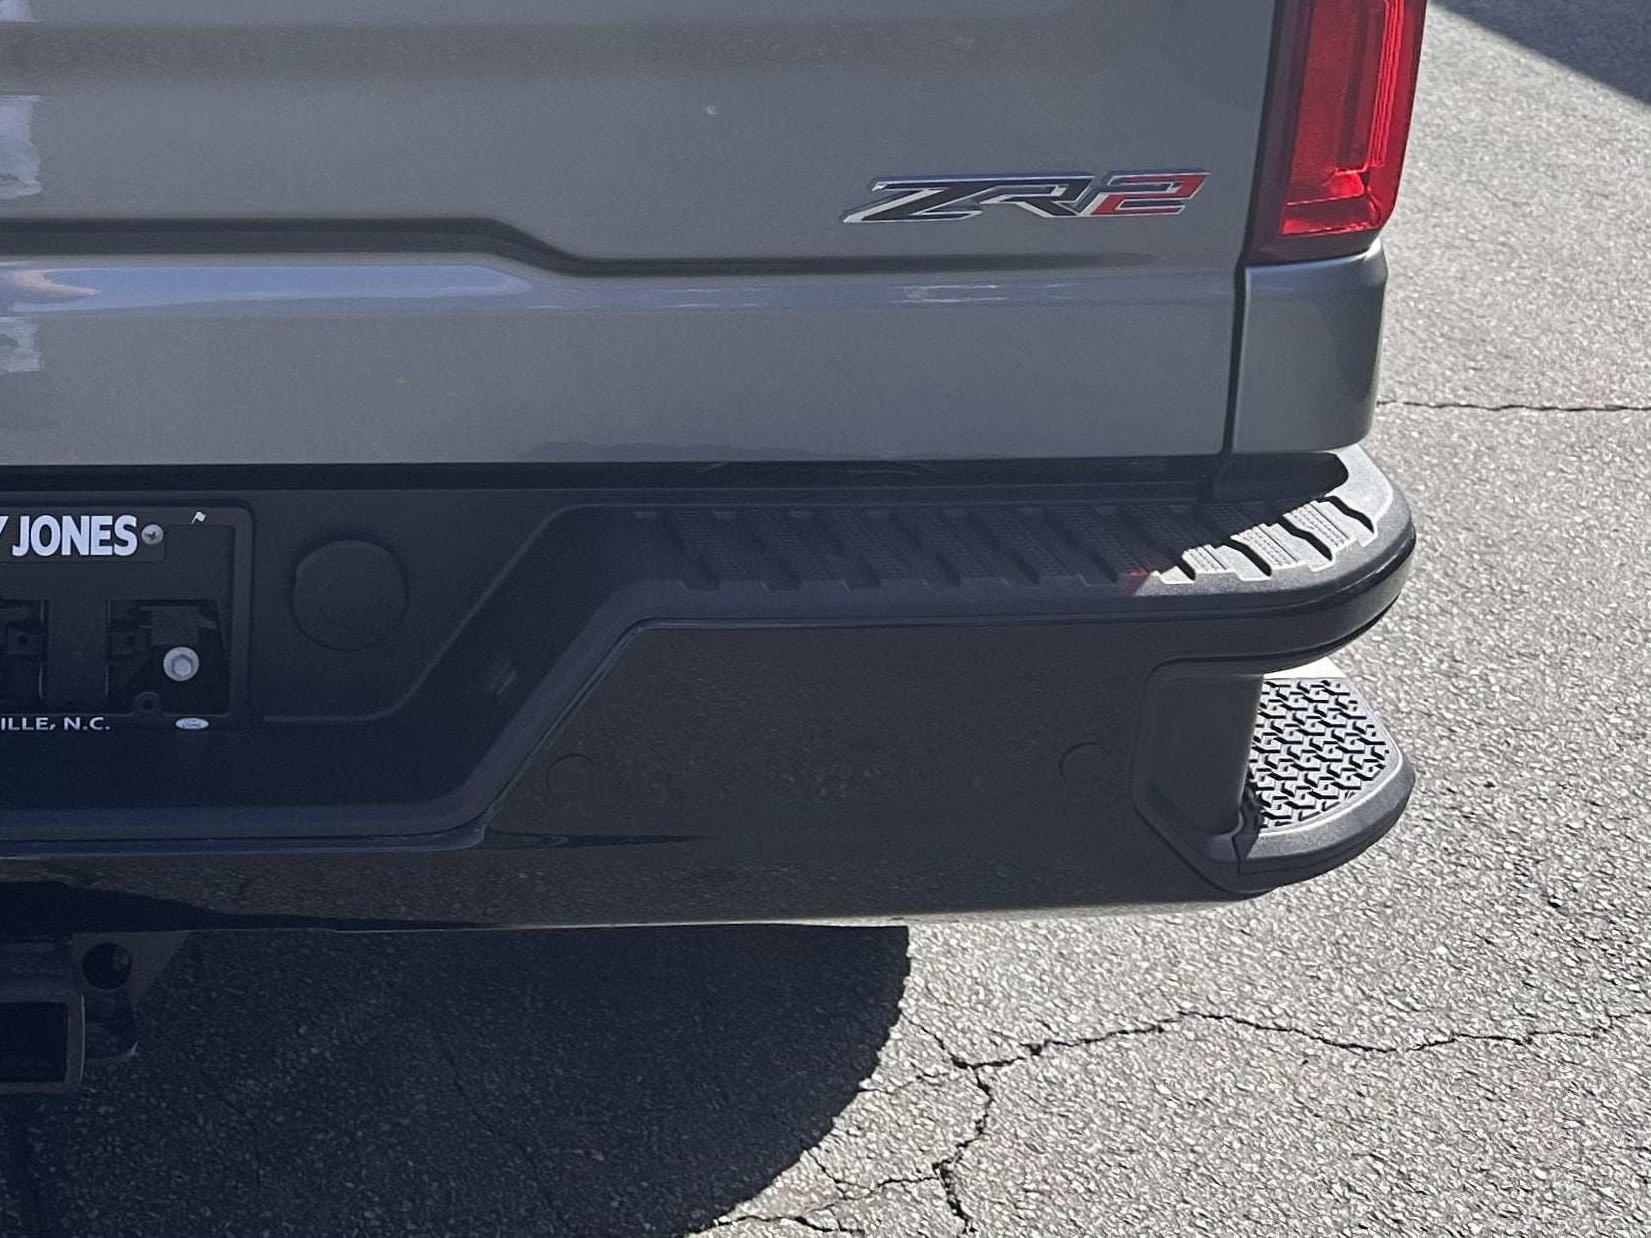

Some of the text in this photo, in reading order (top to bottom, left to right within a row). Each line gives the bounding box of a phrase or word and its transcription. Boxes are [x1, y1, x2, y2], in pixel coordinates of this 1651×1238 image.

[838, 168, 1212, 223] ZR2
[12, 514, 138, 557] JONES
[63, 716, 111, 731] N.C.
